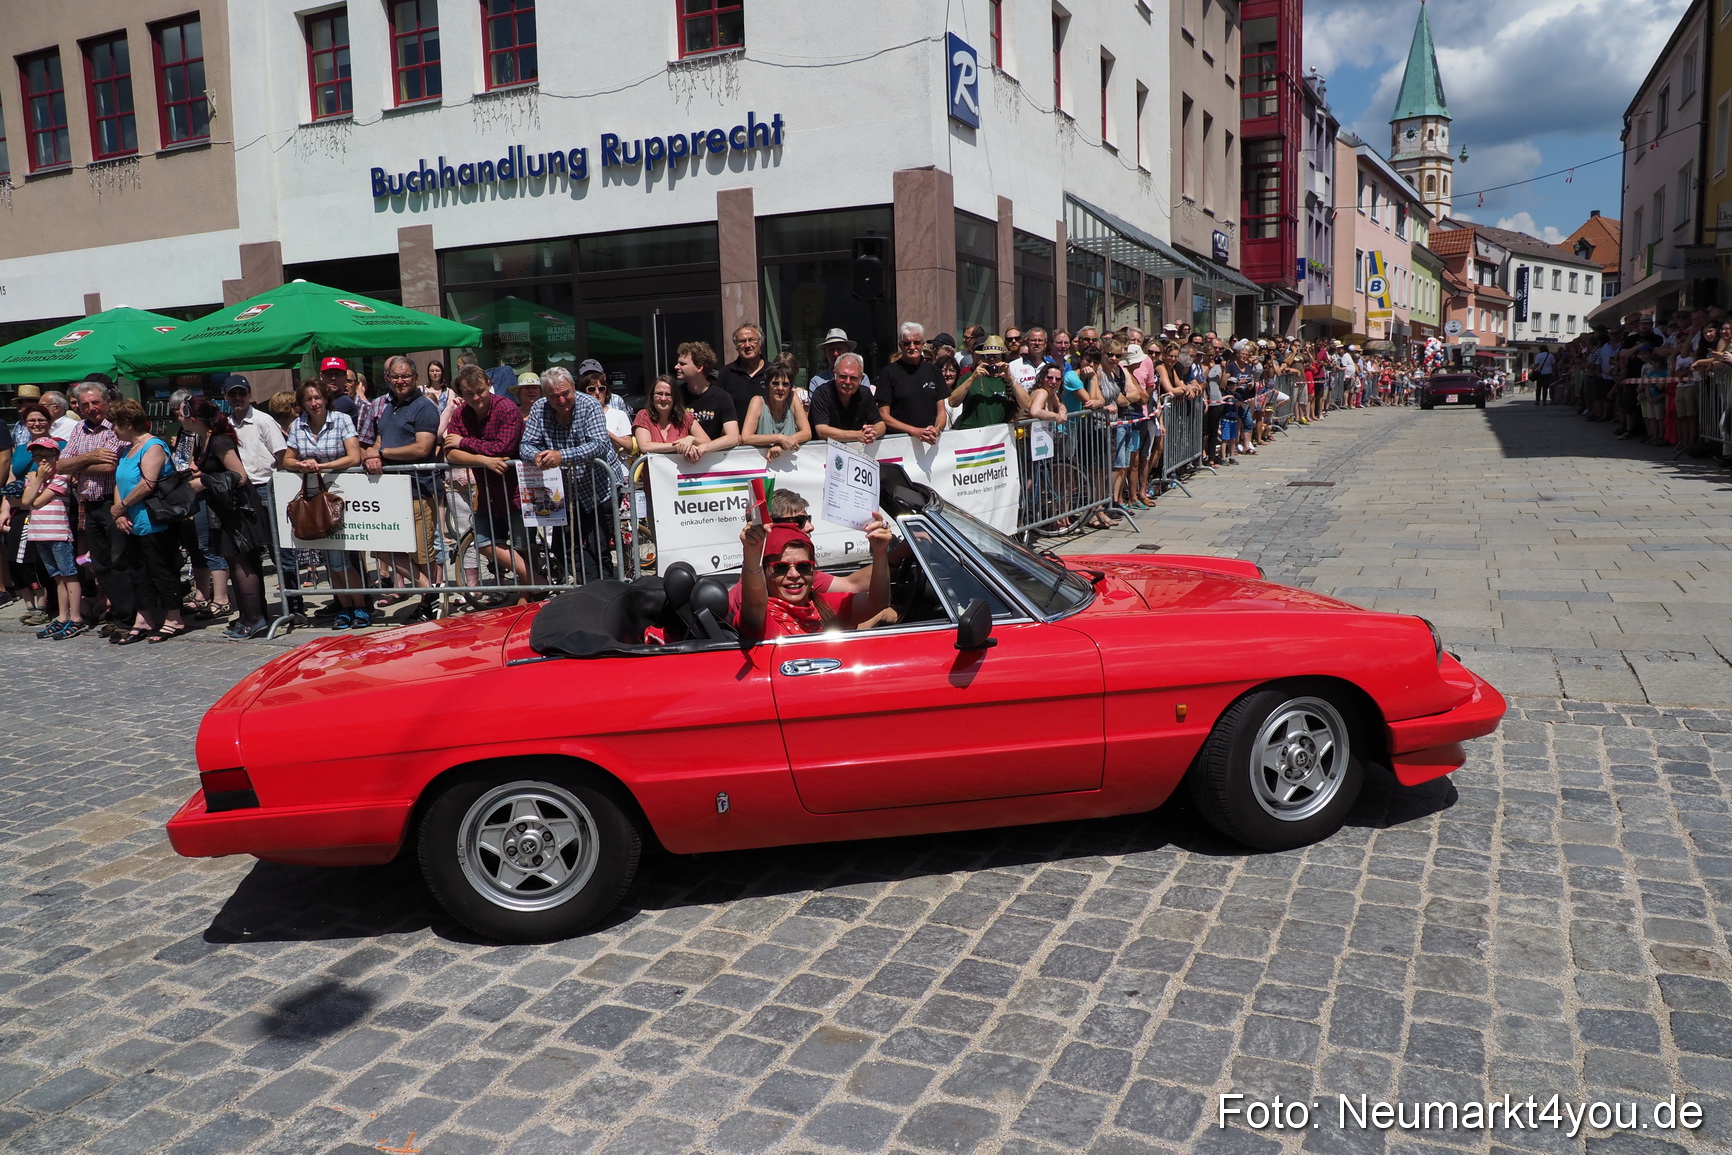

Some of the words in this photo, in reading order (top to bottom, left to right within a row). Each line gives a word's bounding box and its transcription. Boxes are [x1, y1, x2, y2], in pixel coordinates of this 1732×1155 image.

[370, 144, 589, 197] Buchhandlung
[600, 111, 785, 171] Rupprecht
[1370, 280, 1382, 292] B
[502, 333, 529, 342] OLDTIMER
[854, 466, 873, 487] 290
[952, 465, 1008, 487] NeuerMarkt
[343, 500, 381, 512] ress
[341, 521, 401, 531] emeinschaft
[680, 516, 714, 526] einkaufen
[717, 515, 737, 523] leben
[844, 541, 855, 555] P
